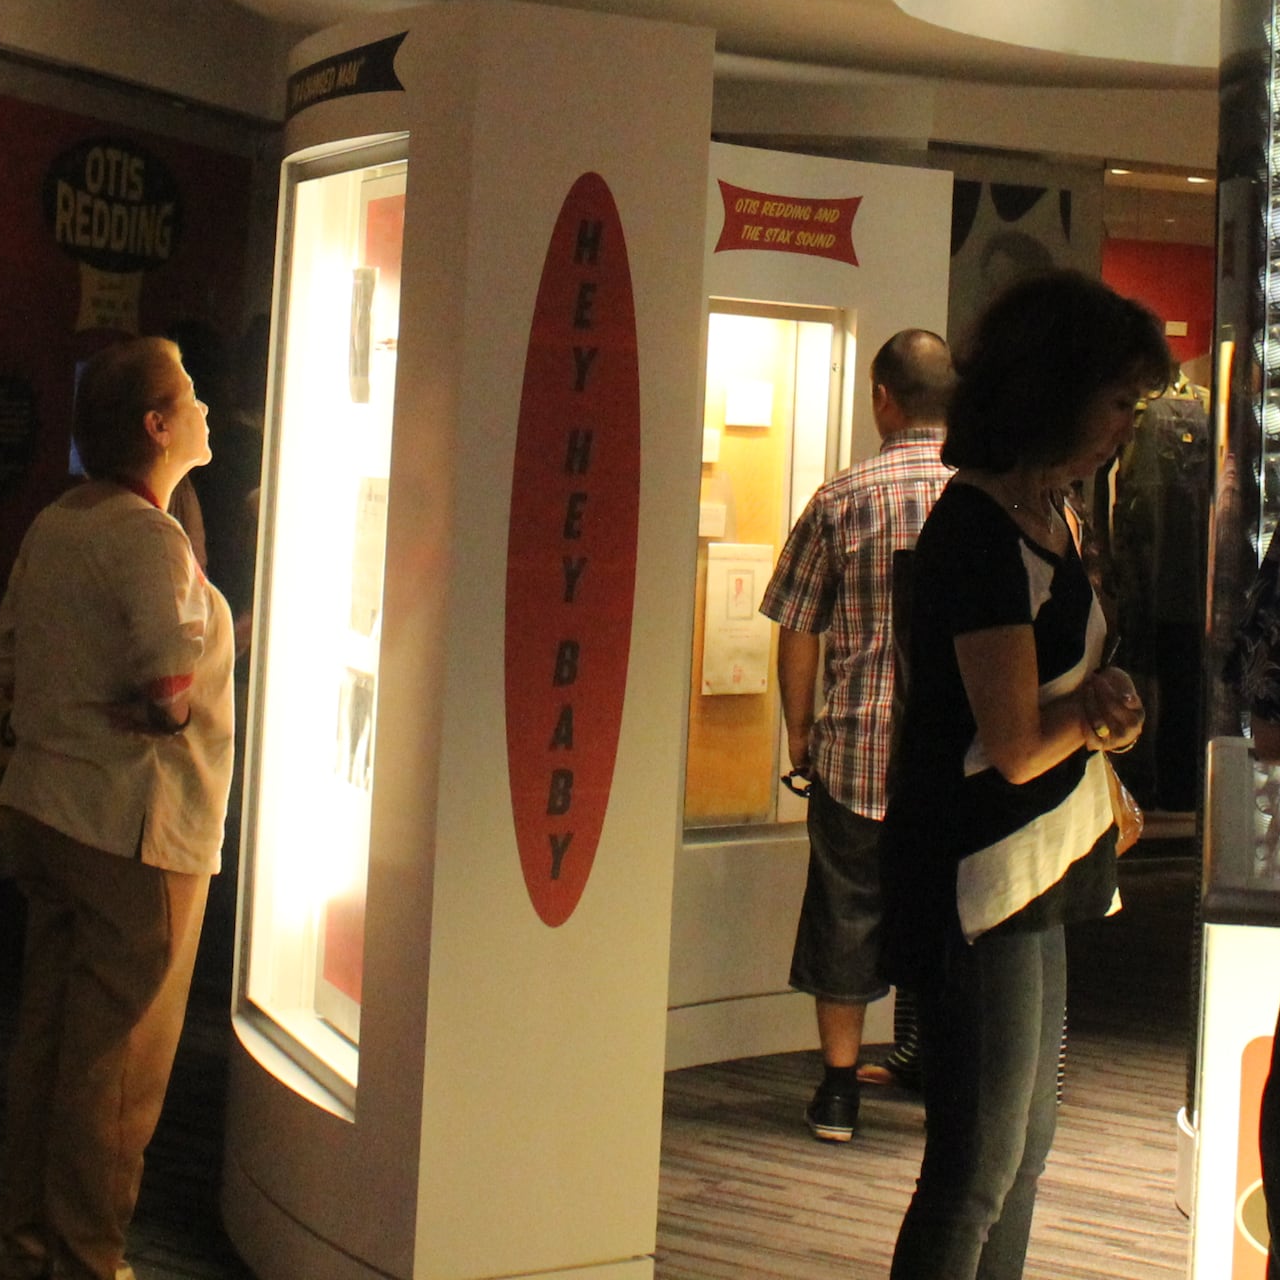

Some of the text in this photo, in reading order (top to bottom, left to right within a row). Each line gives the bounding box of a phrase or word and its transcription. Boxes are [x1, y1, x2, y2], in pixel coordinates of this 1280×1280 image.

[85, 146, 145, 202] OTIS
[56, 179, 175, 259] REDDING
[735, 198, 841, 224] OTIS REDDING AND
[741, 224, 837, 249] THE STAX SOUND
[545, 218, 603, 881] HEY HEY BABY
